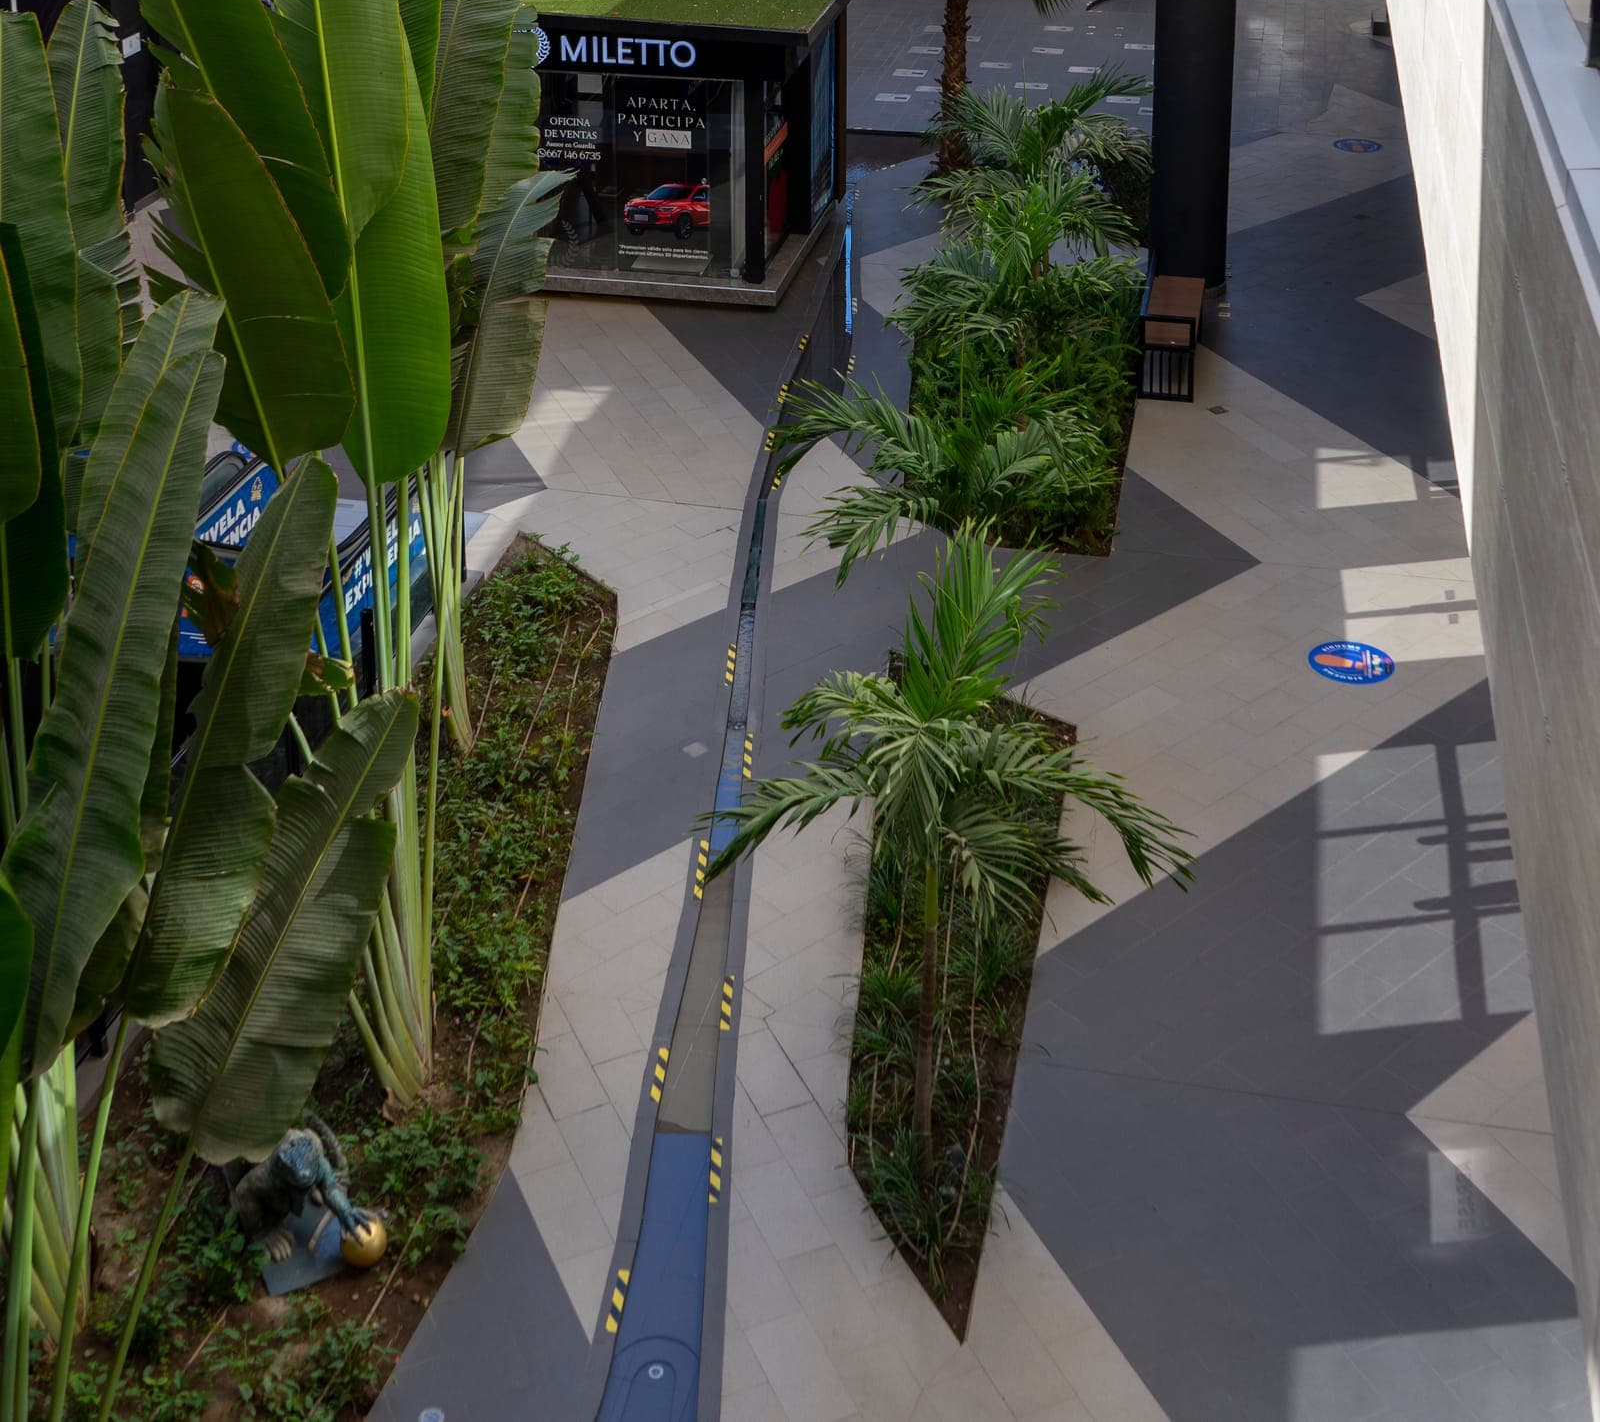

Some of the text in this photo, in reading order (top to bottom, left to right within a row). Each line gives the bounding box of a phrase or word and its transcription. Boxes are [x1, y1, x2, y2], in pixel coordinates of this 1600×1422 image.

[560, 35, 696, 68] MILETTO
[549, 116, 591, 127] OFICINA
[617, 112, 706, 129] PARTICIPA
[544, 129, 597, 140] DE VENTAS
[633, 131, 691, 146] Y GANA
[572, 141, 596, 150] Guardia
[546, 148, 601, 161] 667 146 6735
[199, 497, 246, 542] IVELA
